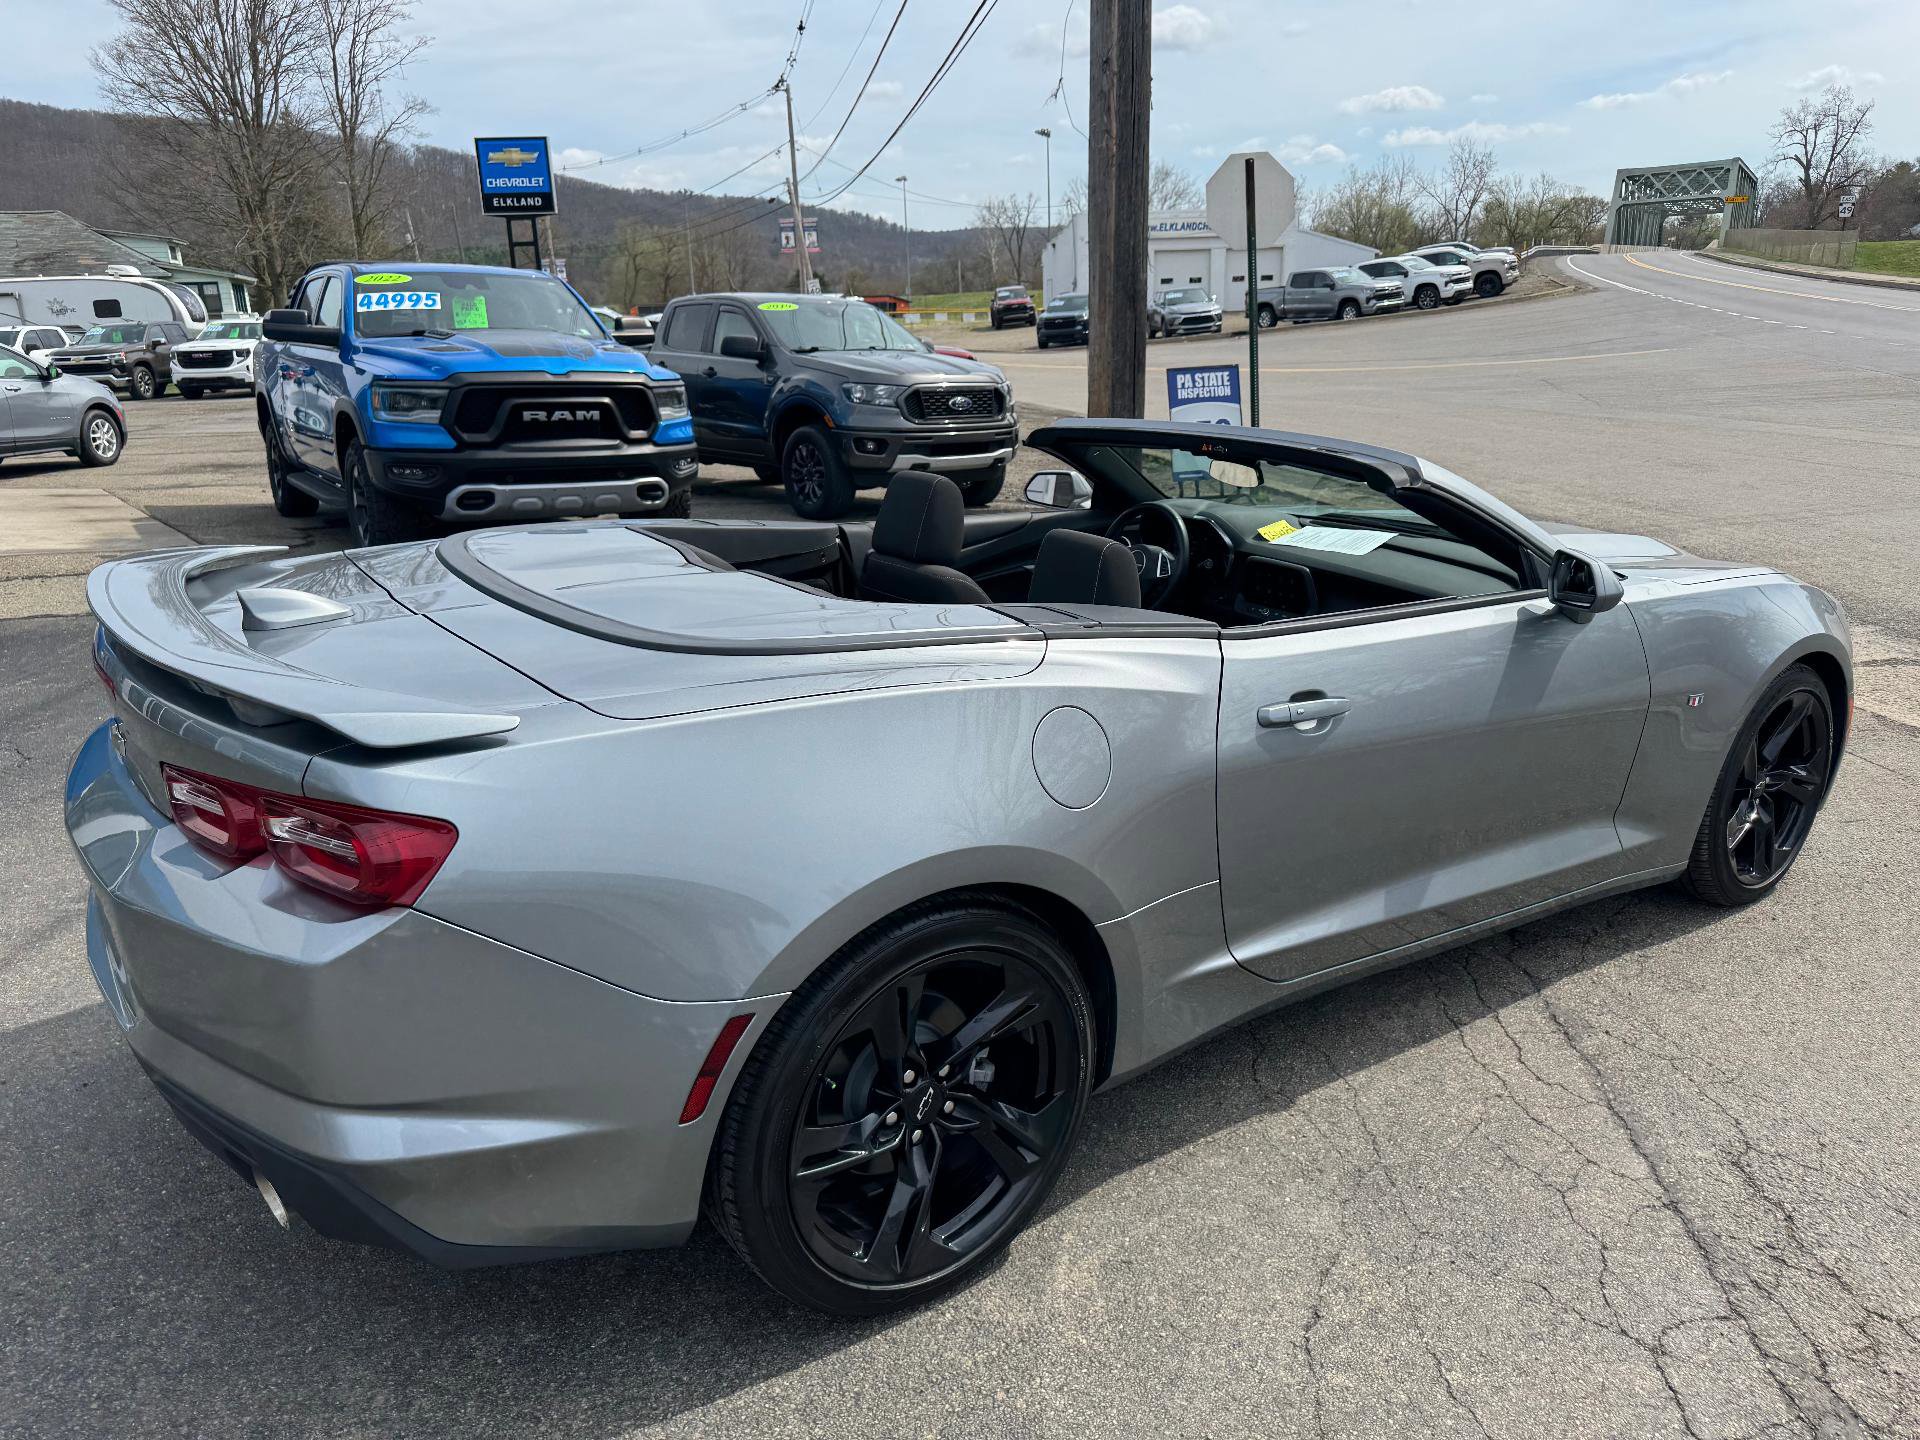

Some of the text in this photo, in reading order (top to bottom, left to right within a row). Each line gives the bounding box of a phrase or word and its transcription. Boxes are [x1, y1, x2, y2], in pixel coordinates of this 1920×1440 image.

[486, 177, 544, 188] CHEVROLET
[493, 197, 542, 207] ELKLAND
[1840, 206, 1853, 215] 49
[364, 275, 402, 283] 2022
[358, 293, 439, 310] 44995
[1176, 371, 1231, 389] PA STATE
[1177, 385, 1231, 400] INSPECTION
[522, 410, 601, 421] RAM
